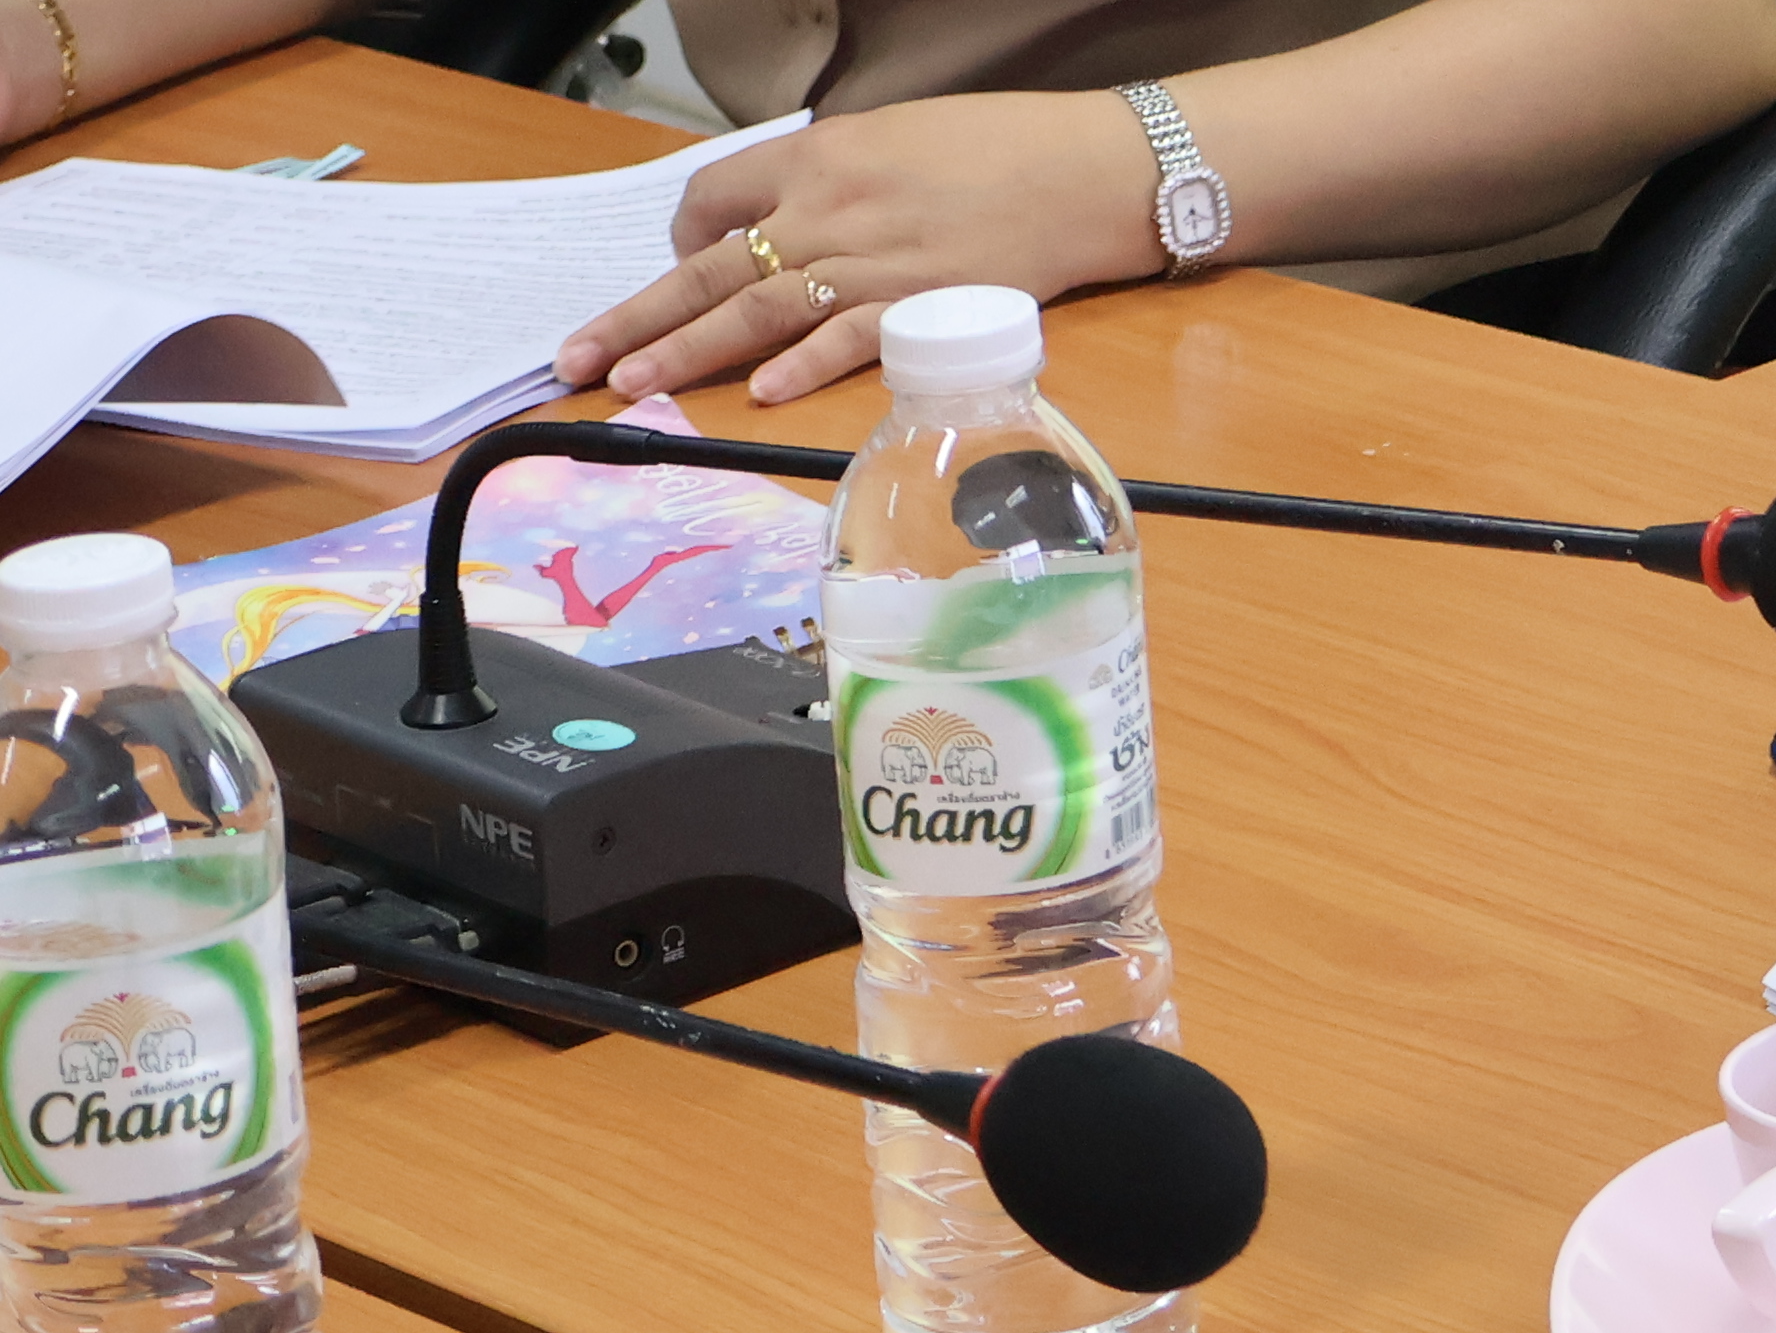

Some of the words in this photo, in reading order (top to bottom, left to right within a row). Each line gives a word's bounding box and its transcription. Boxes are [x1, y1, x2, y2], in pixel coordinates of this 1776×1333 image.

[493, 736, 588, 773] NPE
[459, 803, 535, 860] NPE
[862, 784, 1036, 853] Chang
[29, 1080, 236, 1149] Chang
